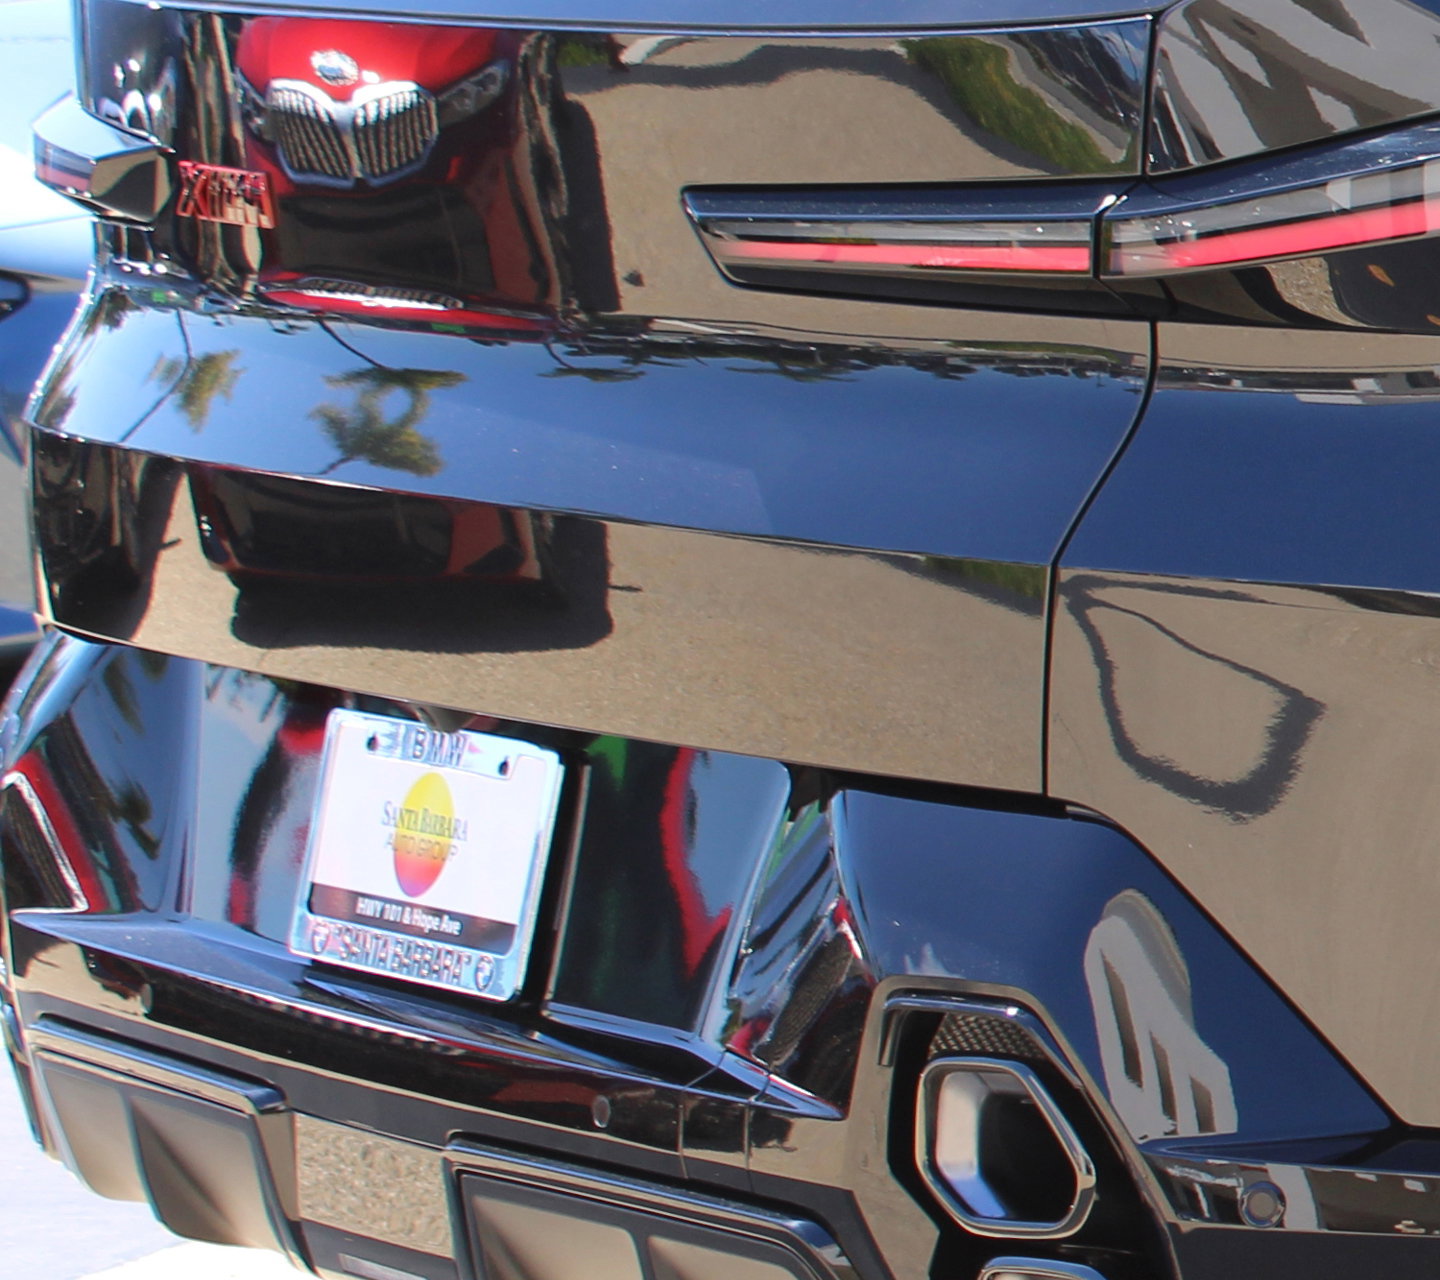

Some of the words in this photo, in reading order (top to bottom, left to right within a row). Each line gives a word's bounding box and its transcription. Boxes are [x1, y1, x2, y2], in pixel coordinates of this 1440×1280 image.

[412, 726, 468, 767] BMW
[381, 800, 420, 833] SANTA
[420, 807, 469, 842] BARBARA
[356, 896, 383, 919] HWY
[382, 903, 402, 923] 101
[411, 907, 440, 934] Hope
[439, 914, 462, 936] Ave
